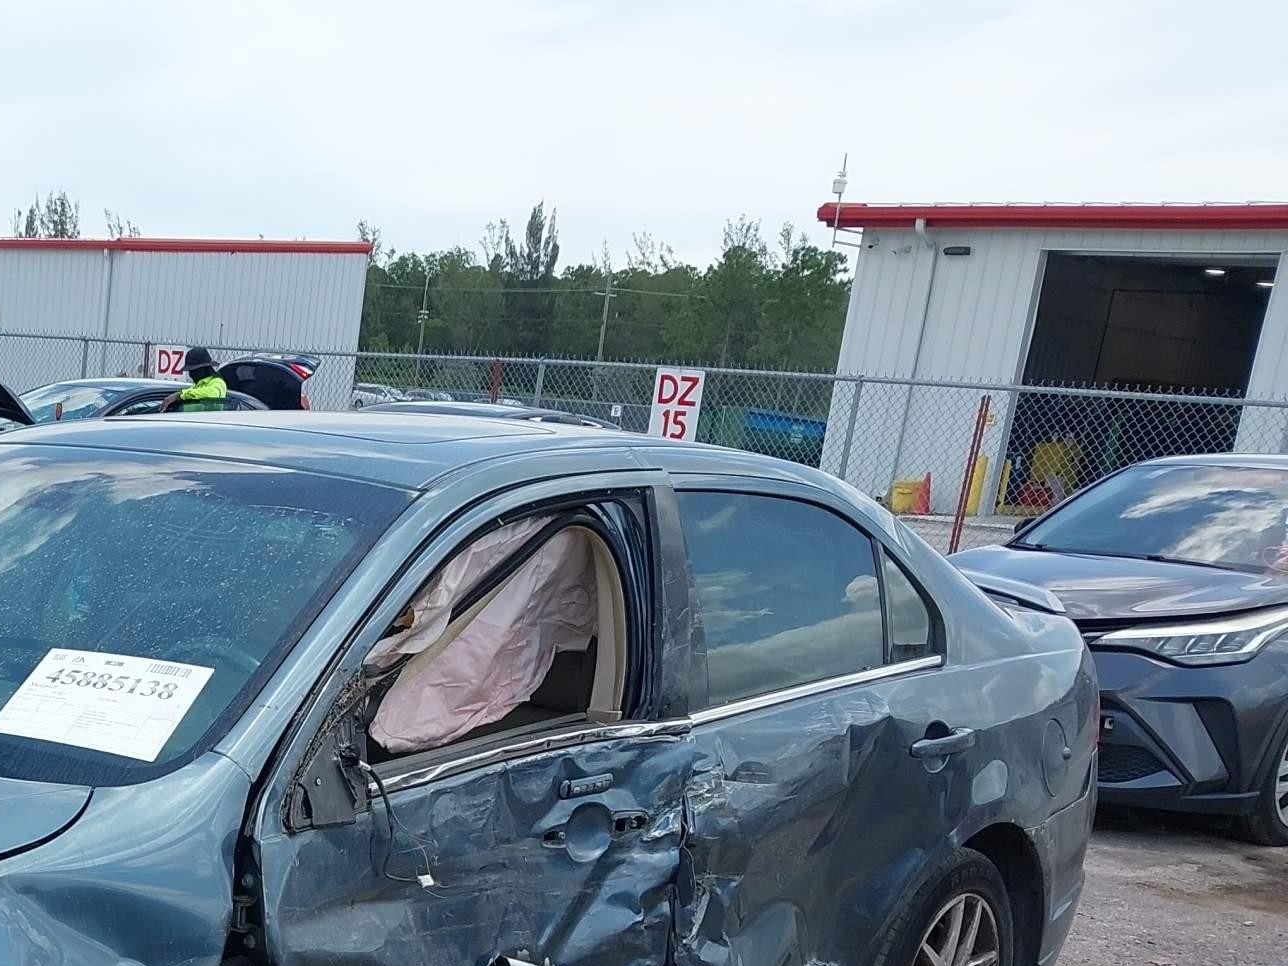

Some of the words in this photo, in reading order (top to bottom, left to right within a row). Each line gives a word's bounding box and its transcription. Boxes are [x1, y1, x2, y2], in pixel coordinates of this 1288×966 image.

[157, 349, 184, 375] DZ
[657, 374, 701, 407] DZ
[661, 409, 687, 440] 15
[45, 667, 179, 700] 45885138
